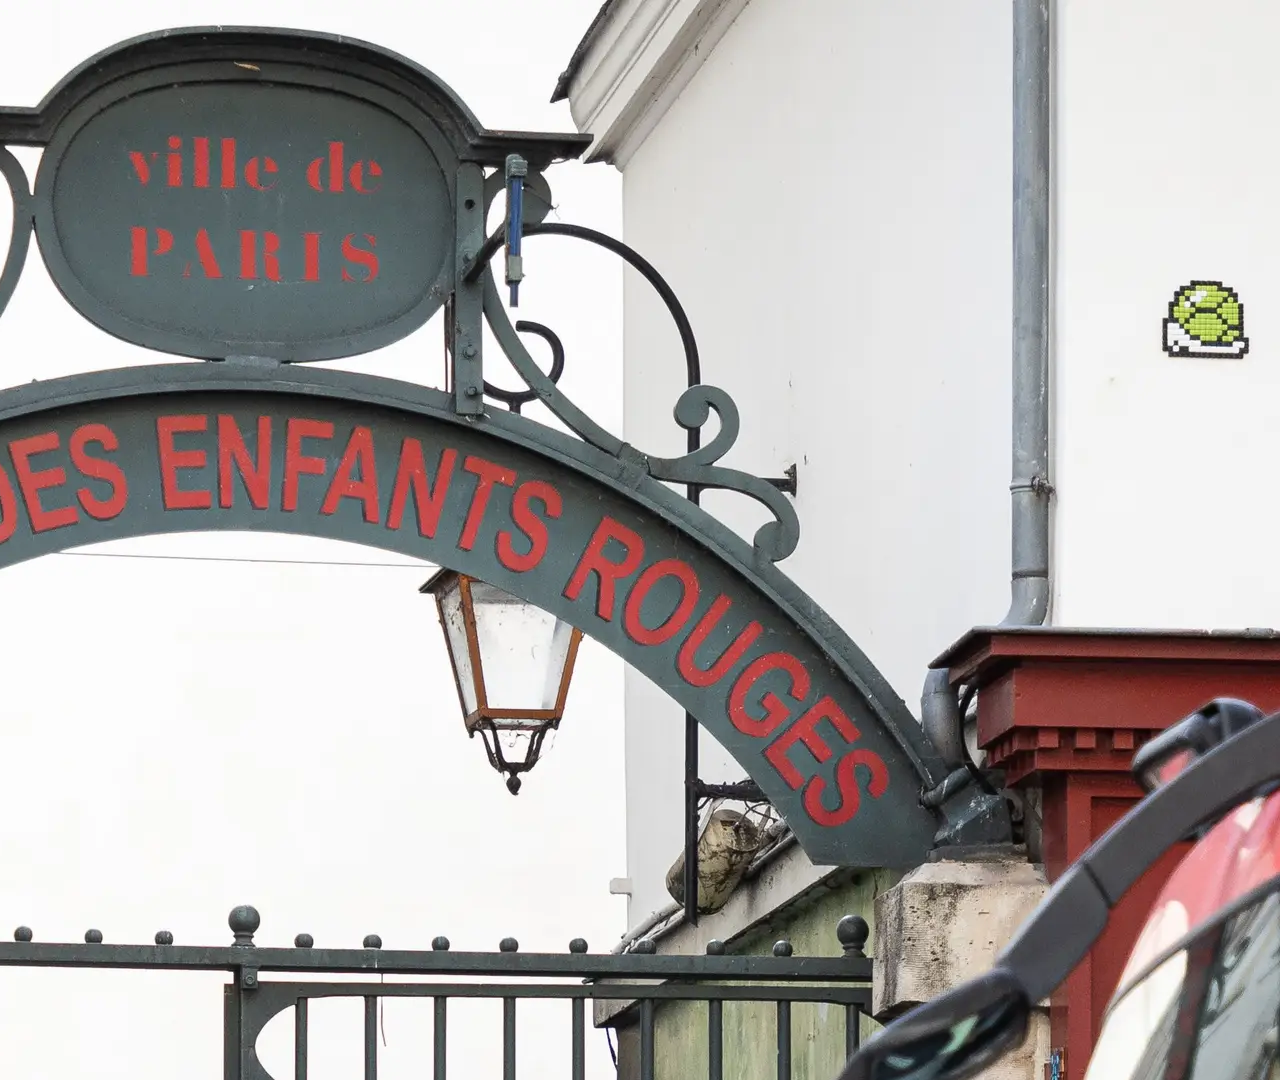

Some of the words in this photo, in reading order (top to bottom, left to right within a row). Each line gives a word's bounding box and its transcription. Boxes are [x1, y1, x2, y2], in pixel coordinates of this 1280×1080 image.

[130, 136, 279, 192] ville
[307, 141, 384, 194] de
[130, 226, 381, 283] PARIS
[157, 415, 562, 572] ENFANTS
[564, 516, 889, 827] ROUGES
